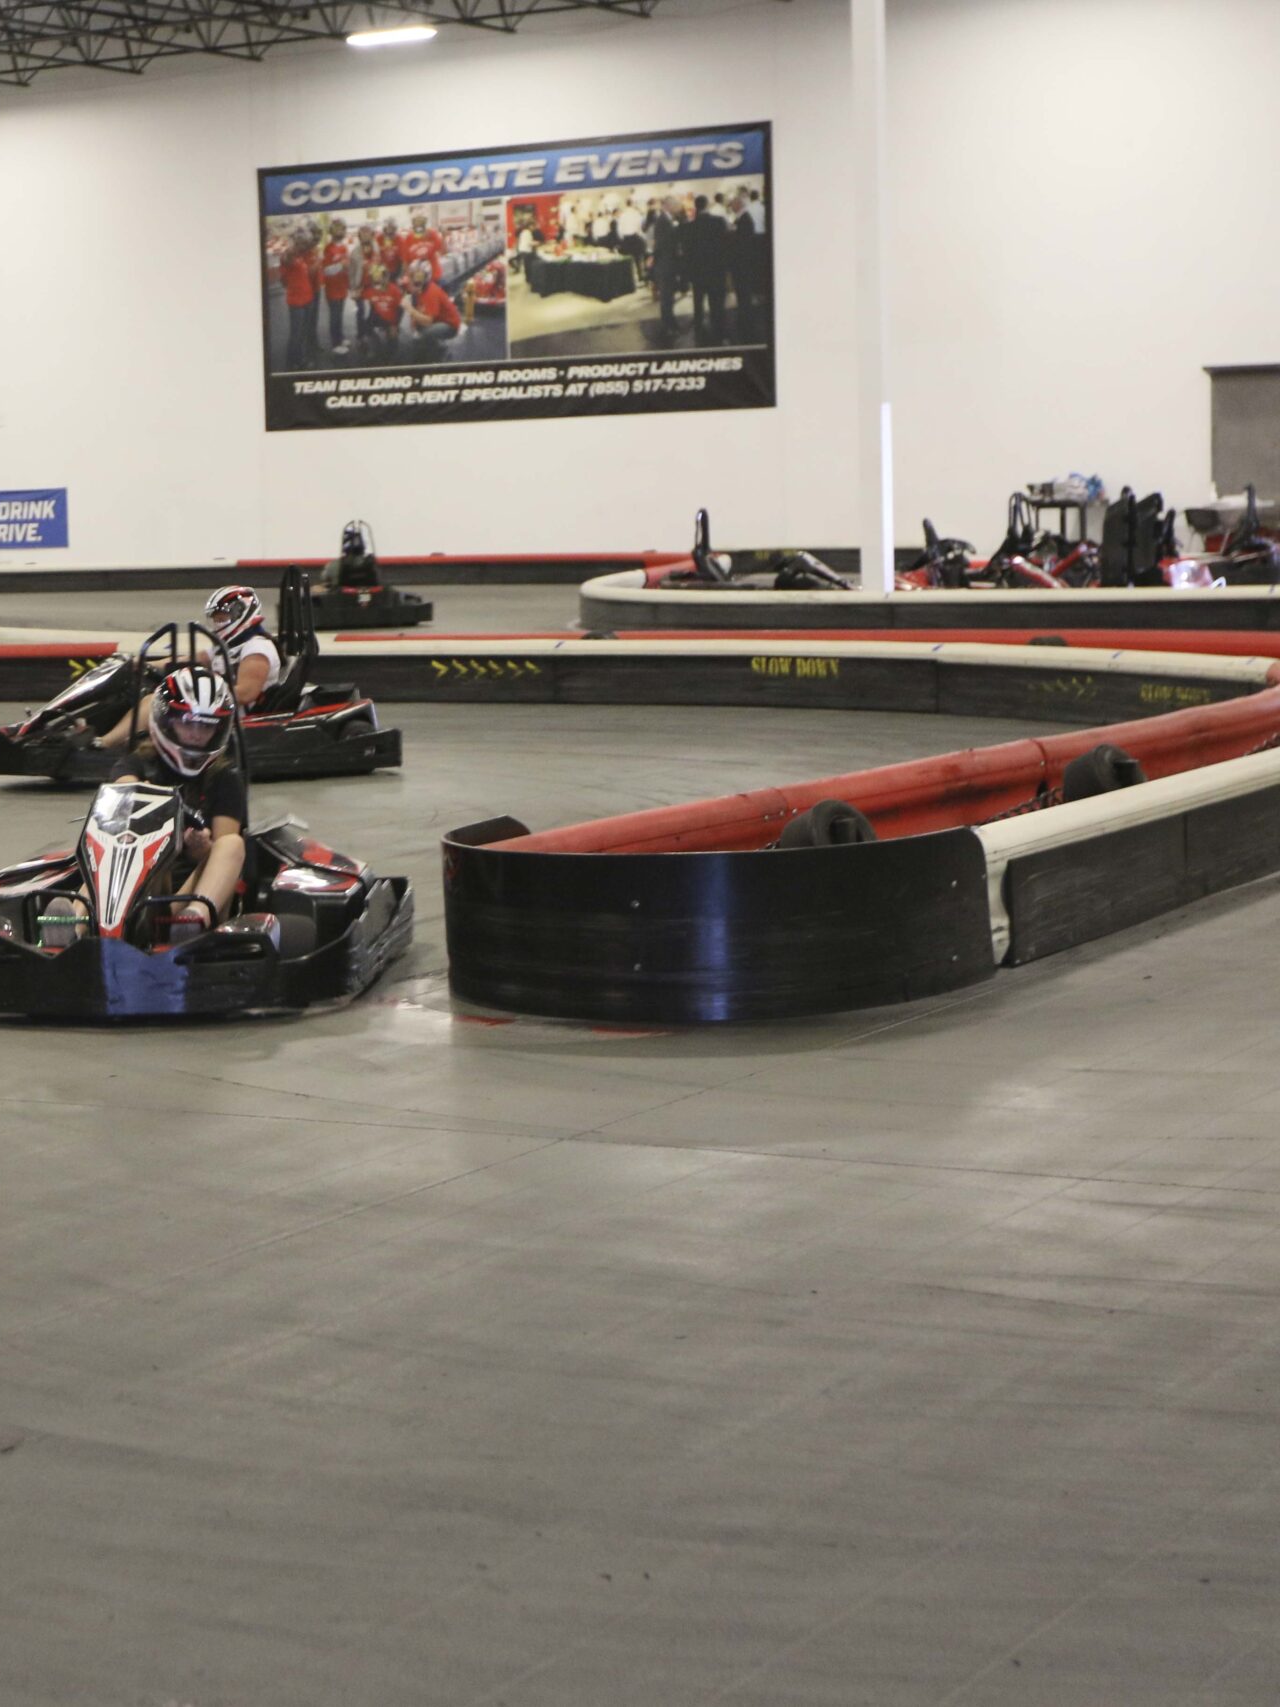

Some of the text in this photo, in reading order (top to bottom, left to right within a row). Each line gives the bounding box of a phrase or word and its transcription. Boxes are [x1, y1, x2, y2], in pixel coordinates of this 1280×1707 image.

[281, 140, 745, 207] CORPORATE EVENTS
[293, 357, 743, 395] TEAM BUILDING MEETING ROOMS PRODUCT LAUNCHES
[325, 396, 366, 409] CALL
[368, 394, 405, 407] OUR
[404, 390, 460, 405] EVENT
[460, 384, 564, 402] SPECIALISTS
[565, 383, 589, 396] AT
[631, 378, 707, 393] 517-7333
[751, 656, 839, 678] SLOW DOWN
